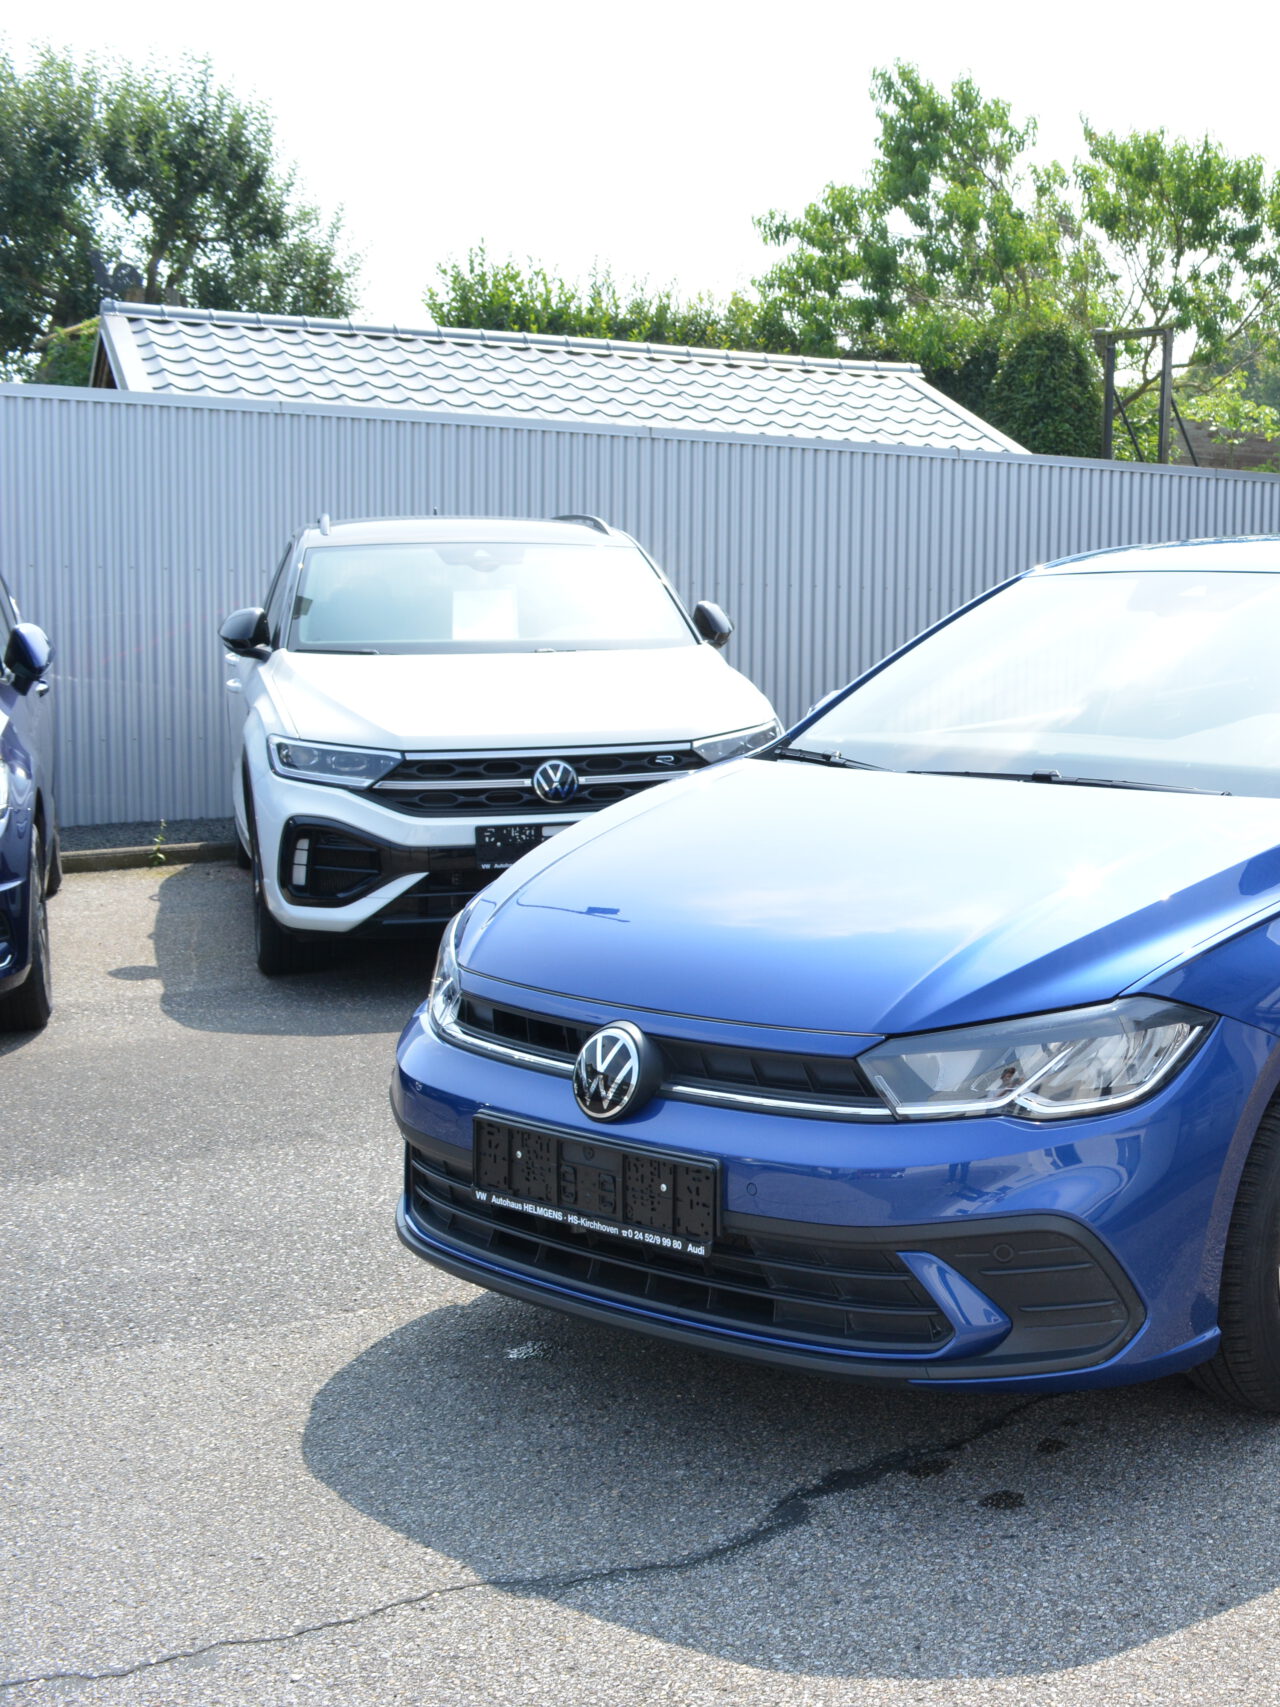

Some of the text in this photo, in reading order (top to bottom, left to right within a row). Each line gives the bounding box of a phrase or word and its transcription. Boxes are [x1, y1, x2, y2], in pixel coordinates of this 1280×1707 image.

[534, 759, 579, 804] VW
[574, 1028, 639, 1119] VW
[475, 1190, 488, 1201] VW
[491, 1194, 522, 1211] Autohaus
[523, 1202, 563, 1221] HELMGENS
[567, 1213, 619, 1235] HS-Kirchhoven
[687, 1243, 705, 1256] Audi
